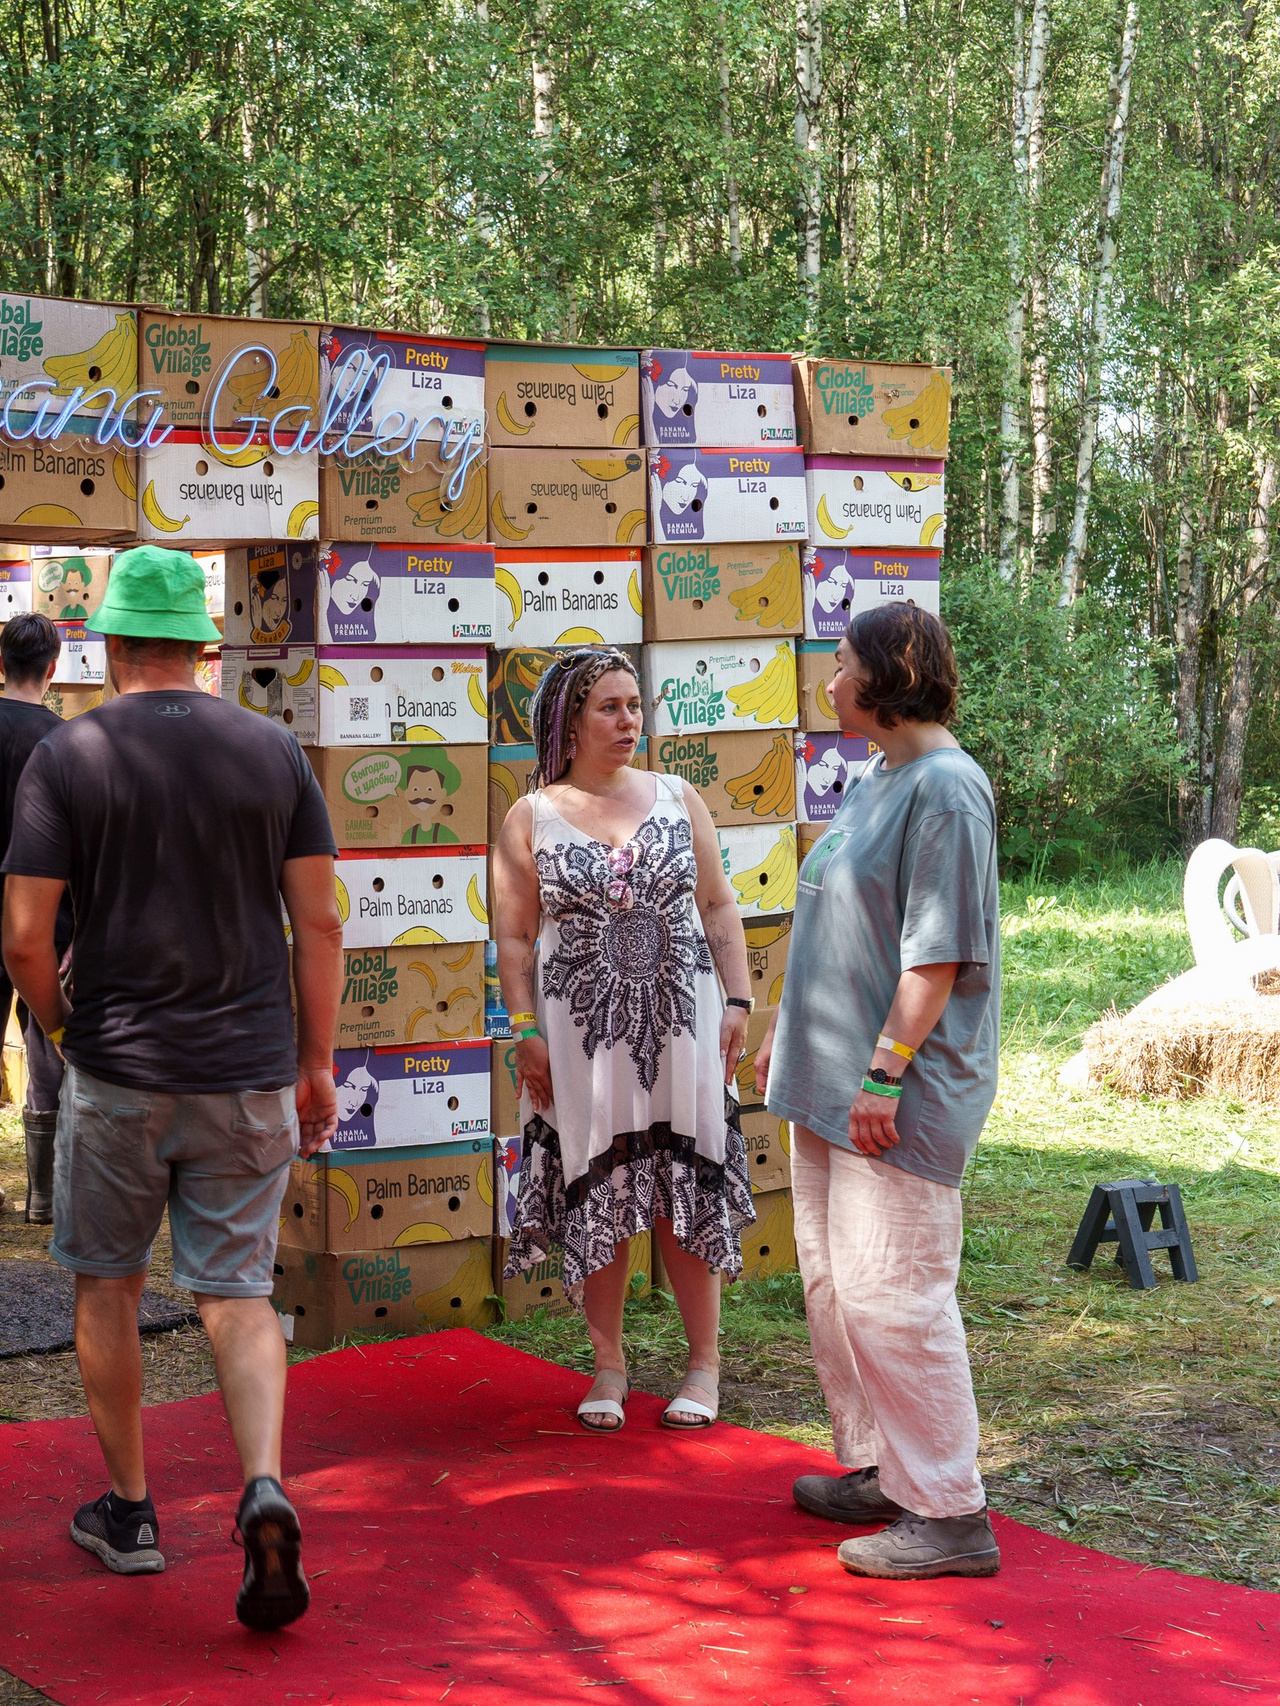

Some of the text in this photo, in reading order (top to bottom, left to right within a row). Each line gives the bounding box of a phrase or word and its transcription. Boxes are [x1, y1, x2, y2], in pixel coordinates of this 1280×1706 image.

[406, 348, 449, 370] Pretty
[412, 372, 442, 390] Liza
[816, 366, 874, 391] Global
[517, 382, 614, 407] Palm Bananas
[821, 390, 875, 418] Village
[209, 345, 483, 501] Gallery
[33, 449, 106, 477] Bananas
[729, 458, 770, 474] Pretty
[180, 484, 283, 506] Palm Bananas
[340, 470, 401, 499] Village
[738, 479, 767, 494] Liza
[344, 515, 383, 526] Premium
[842, 503, 921, 524] Palm Bananas
[360, 526, 397, 535] bananas
[776, 521, 805, 533] PALMAR
[407, 556, 453, 575] Pretty
[657, 548, 719, 577] Global
[874, 561, 909, 578] Pretty
[414, 579, 445, 595] Liza
[662, 574, 721, 602] Village
[880, 581, 904, 596] Liza
[524, 588, 618, 612] Palm Bananas
[453, 625, 491, 637] PALMAR
[397, 695, 457, 718] Bananas
[666, 699, 726, 727] Village
[351, 760, 390, 781] Выгодно
[363, 771, 398, 797] удобно!
[359, 894, 454, 918] Palm Bananas
[404, 1057, 451, 1074] Pretty
[413, 1079, 445, 1095] Liza
[366, 1173, 471, 1202] Palm Bananas
[342, 1250, 411, 1281] Global
[347, 1278, 412, 1305] Village
